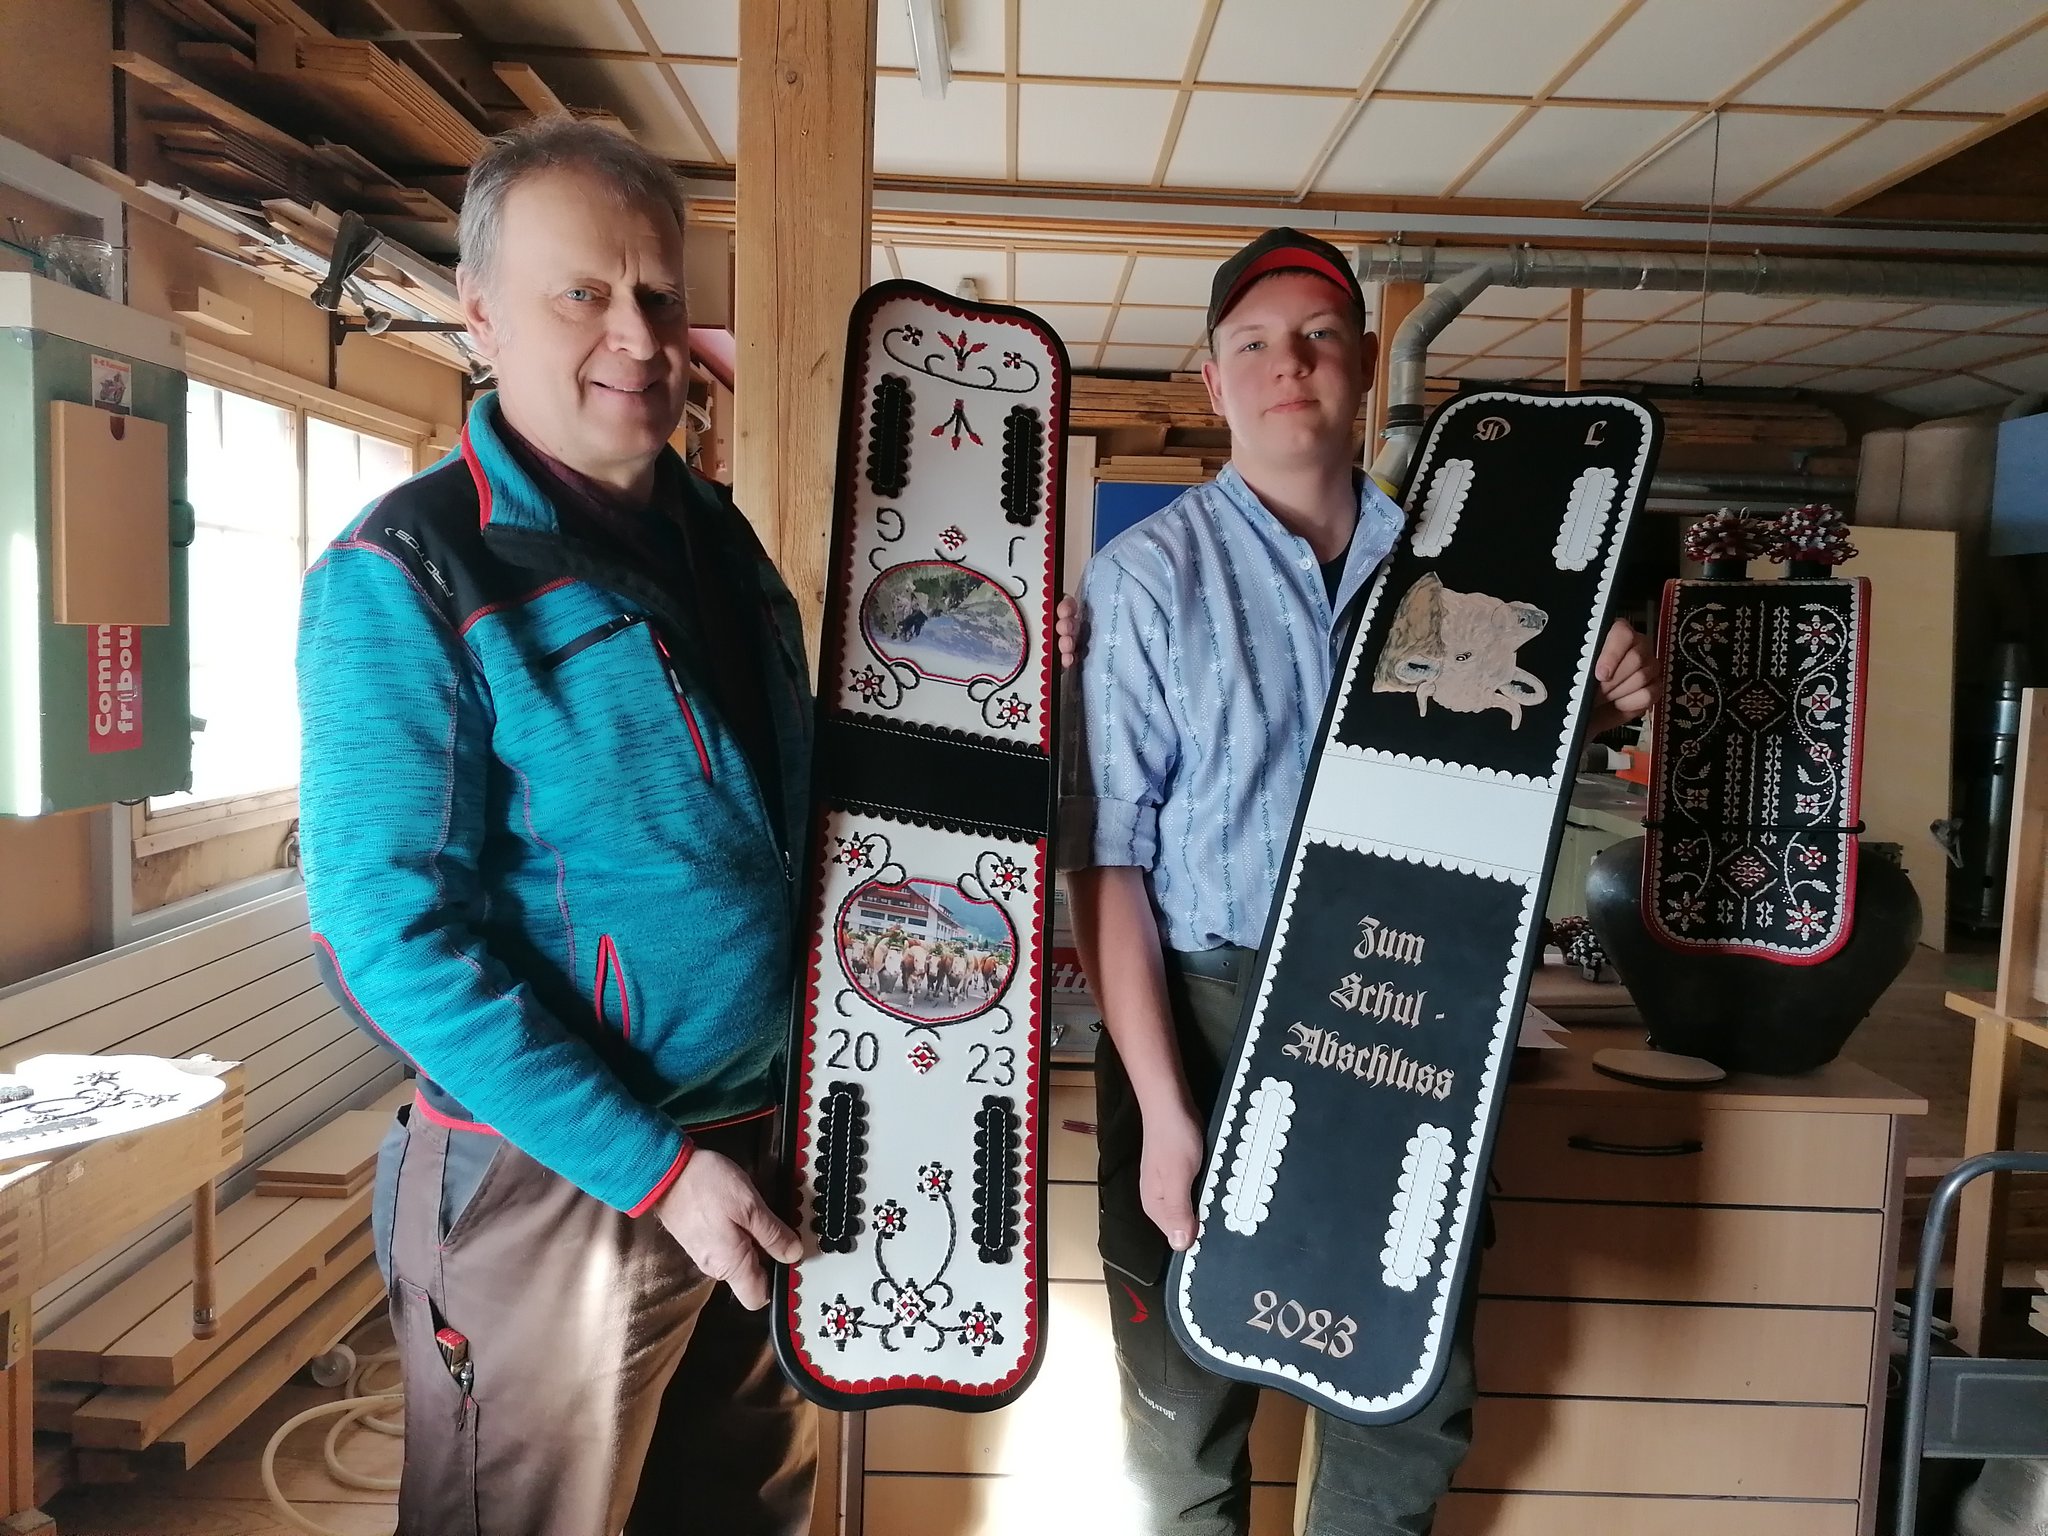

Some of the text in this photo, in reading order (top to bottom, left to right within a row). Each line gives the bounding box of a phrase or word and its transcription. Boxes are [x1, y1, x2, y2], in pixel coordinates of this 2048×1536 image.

[876, 507, 906, 543] G
[394, 529, 455, 598] PROTOS
[1353, 914, 1426, 967] Zum
[1329, 971, 1429, 1029] Schul
[826, 1028, 1016, 1087] 20 23
[1281, 1020, 1456, 1102] Abschluss
[1245, 1290, 1358, 1358] 2023
